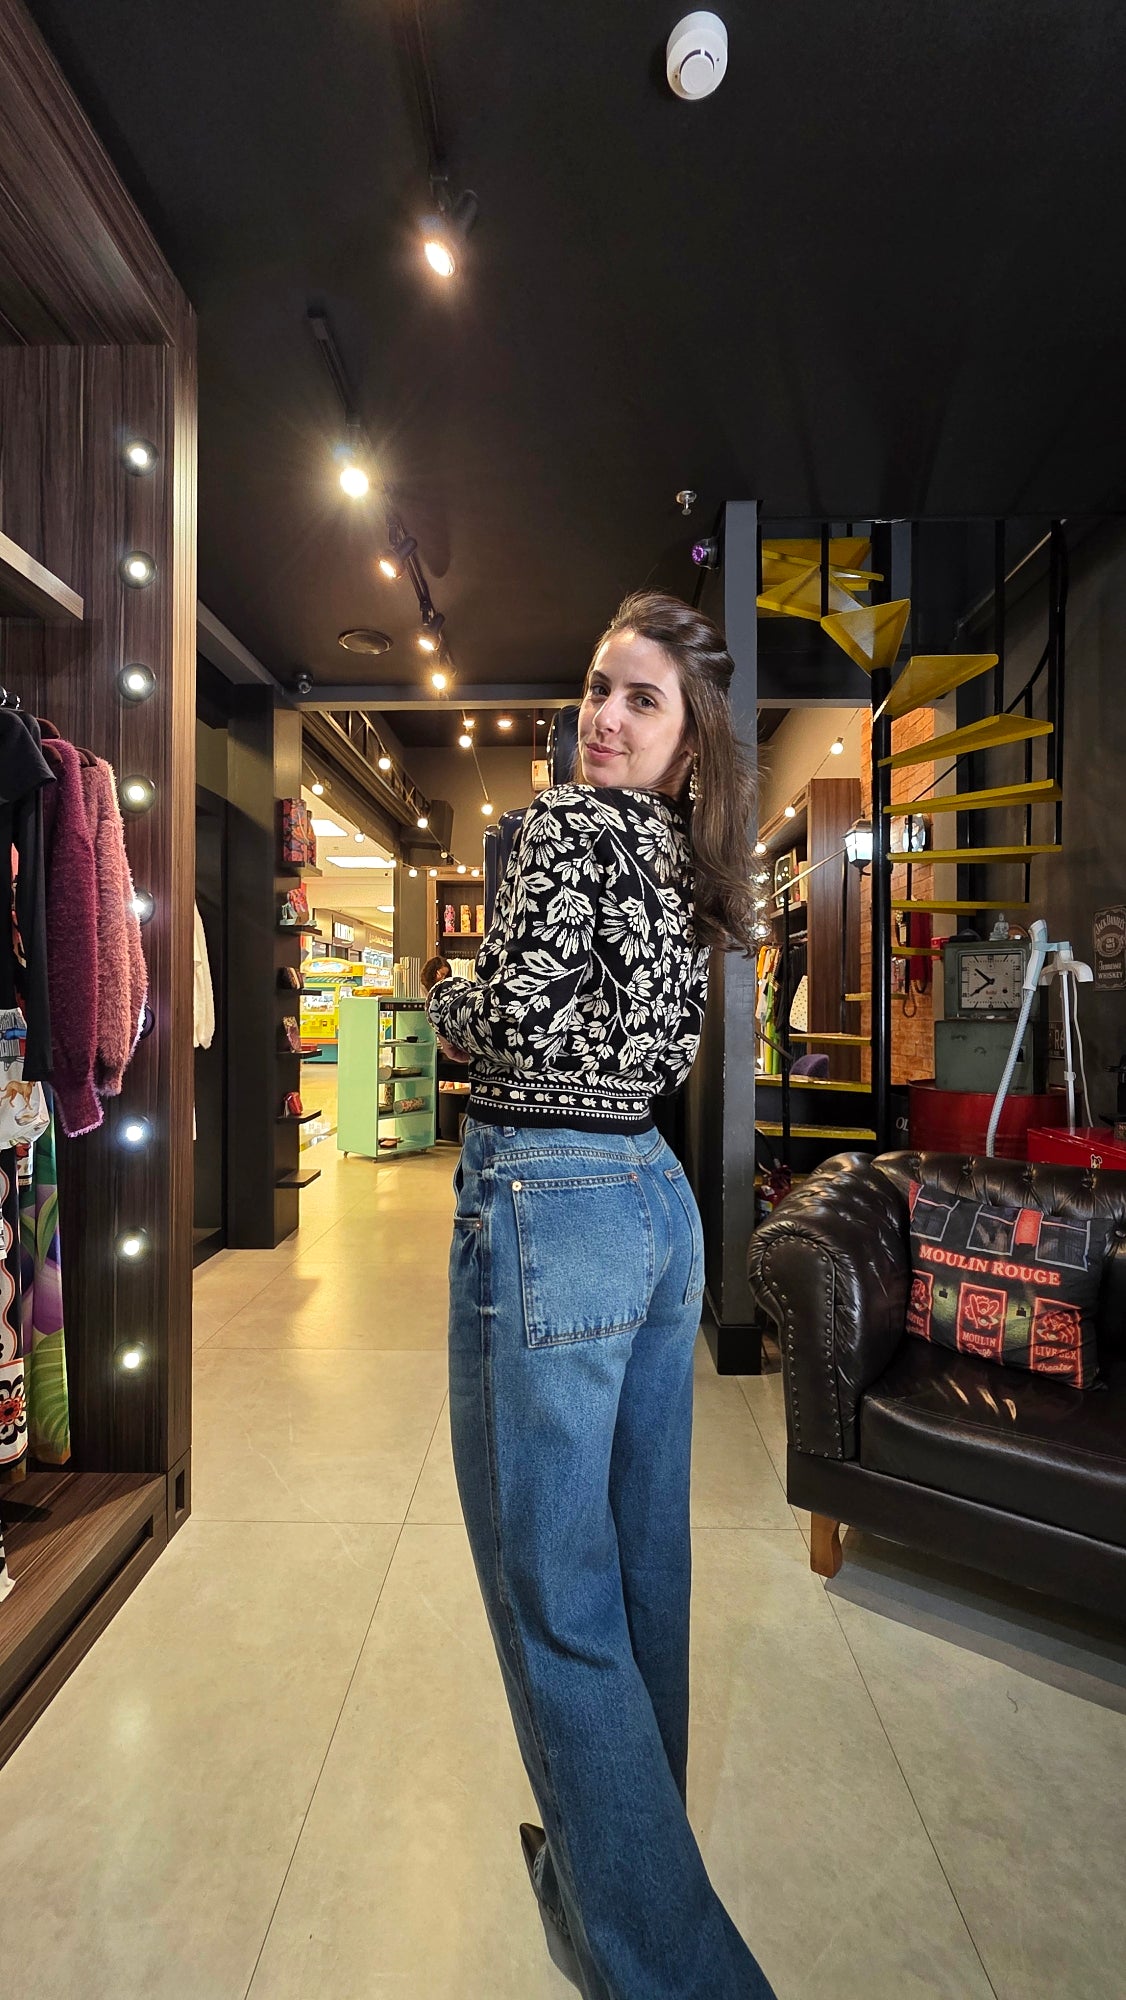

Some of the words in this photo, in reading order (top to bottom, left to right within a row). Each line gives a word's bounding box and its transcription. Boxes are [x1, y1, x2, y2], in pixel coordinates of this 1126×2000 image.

[919, 1244, 990, 1273] MOULIN
[991, 1260, 1061, 1286] ROUGE
[961, 1331, 996, 1347] MOULIN
